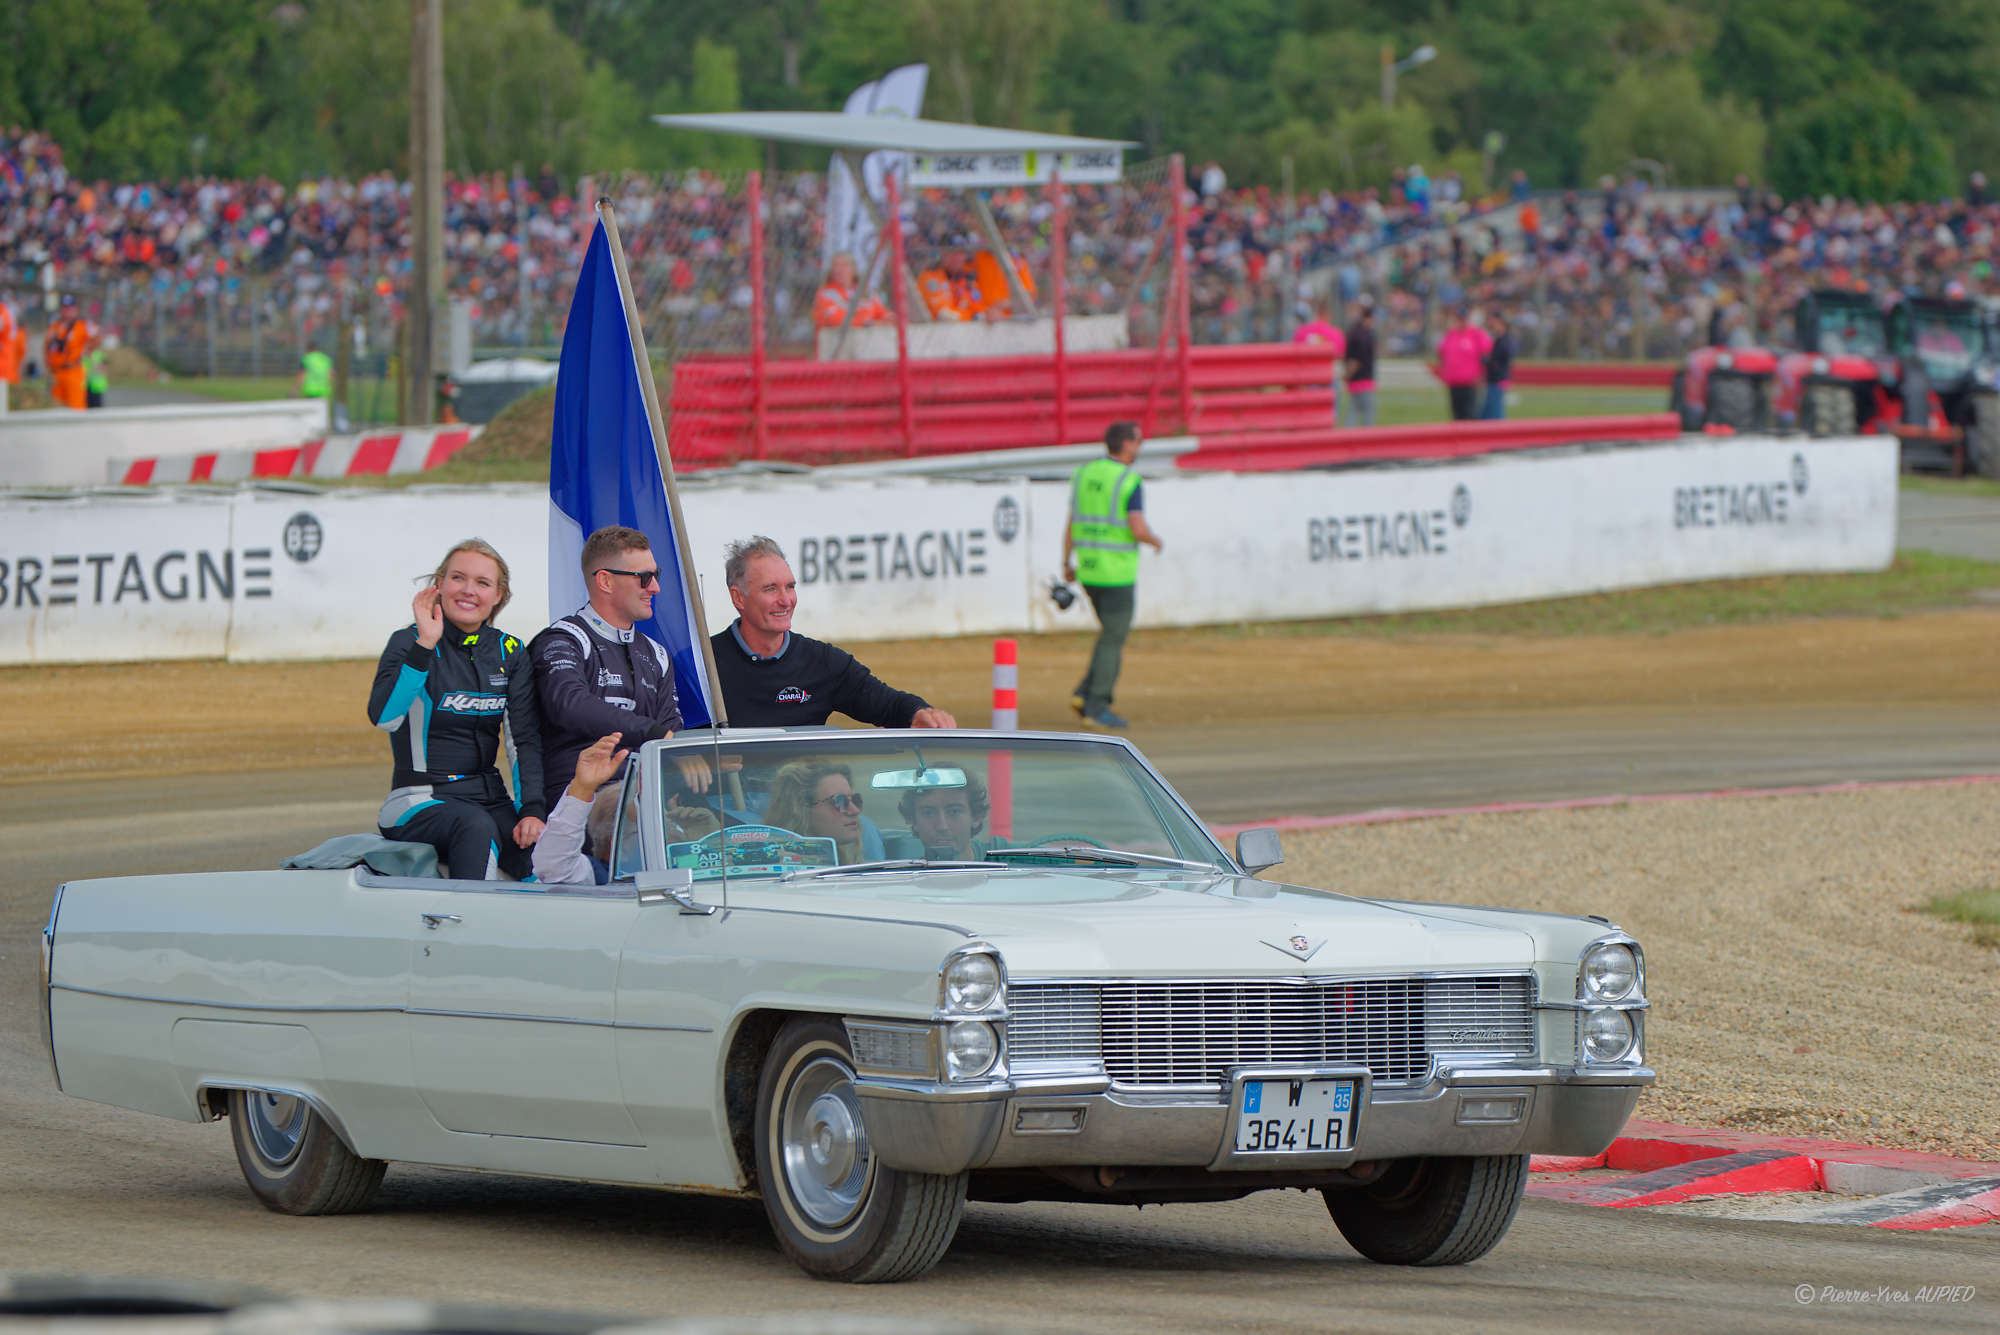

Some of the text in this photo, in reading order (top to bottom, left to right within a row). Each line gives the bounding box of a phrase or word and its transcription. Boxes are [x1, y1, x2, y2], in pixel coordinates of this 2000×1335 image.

[1673, 482, 1788, 530] BRETAGNE
[800, 529, 987, 584] BRETAGNE
[1308, 510, 1448, 562] BRETAGNE
[1334, 1093, 1350, 1109] 35
